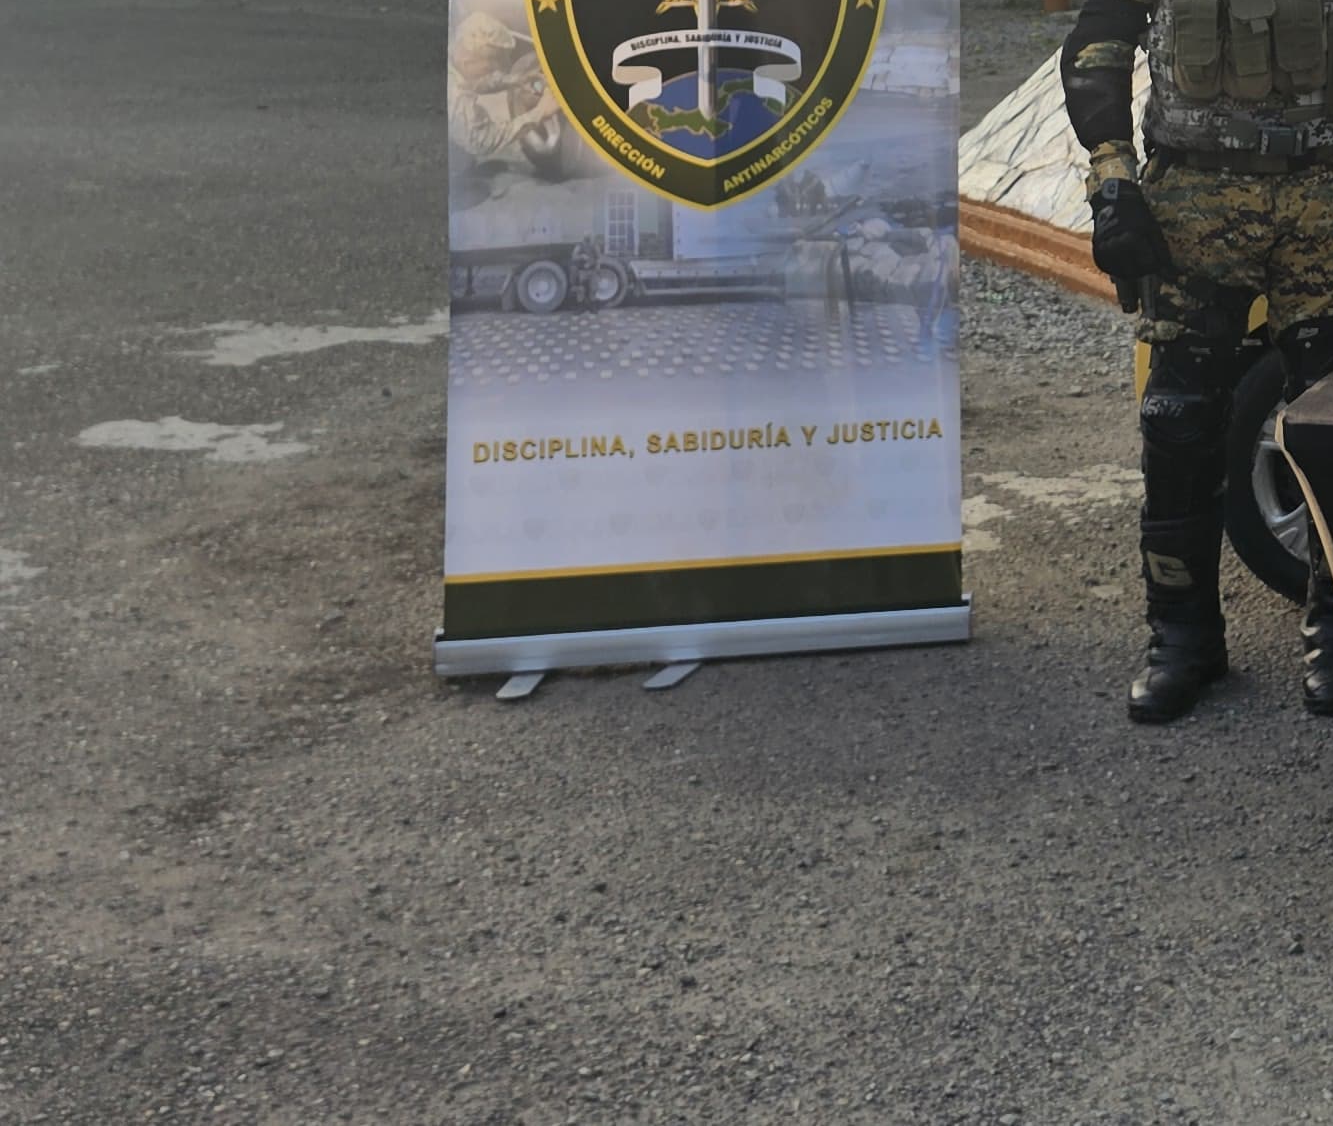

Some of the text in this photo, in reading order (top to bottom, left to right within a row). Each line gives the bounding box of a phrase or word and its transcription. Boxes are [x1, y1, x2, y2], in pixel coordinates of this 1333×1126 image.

[592, 96, 834, 193] DIRECCIÓN ANTINARCÓTICOS
[473, 418, 944, 463] DISCIPLINA, SABIDURÍA Y JUSTICIA
